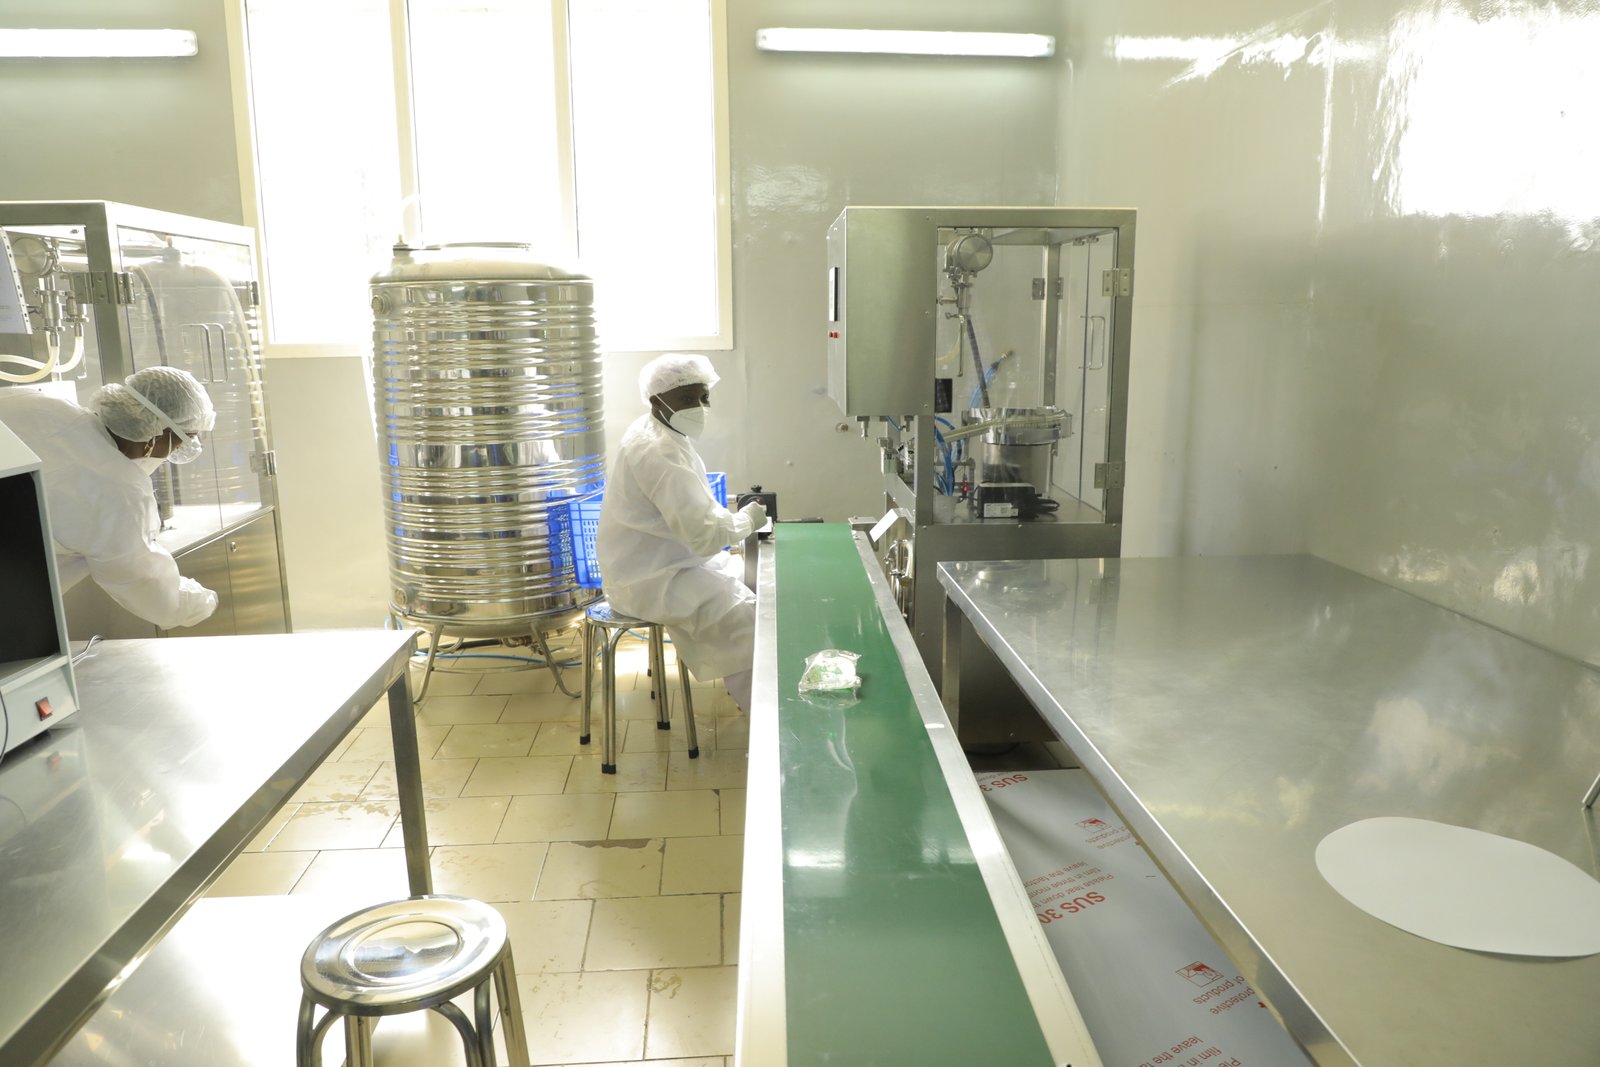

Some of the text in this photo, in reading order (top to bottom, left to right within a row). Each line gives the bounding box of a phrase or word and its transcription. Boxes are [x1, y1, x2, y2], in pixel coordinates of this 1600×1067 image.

[991, 774, 1028, 788] SUS
[1059, 892, 1106, 914] SUS
[1192, 975, 1245, 1005] of products
[1209, 986, 1255, 1015] protective
[1152, 1036, 1204, 1064] leave the
[1186, 1046, 1222, 1067] film in
[1218, 1056, 1242, 1067] Ple
